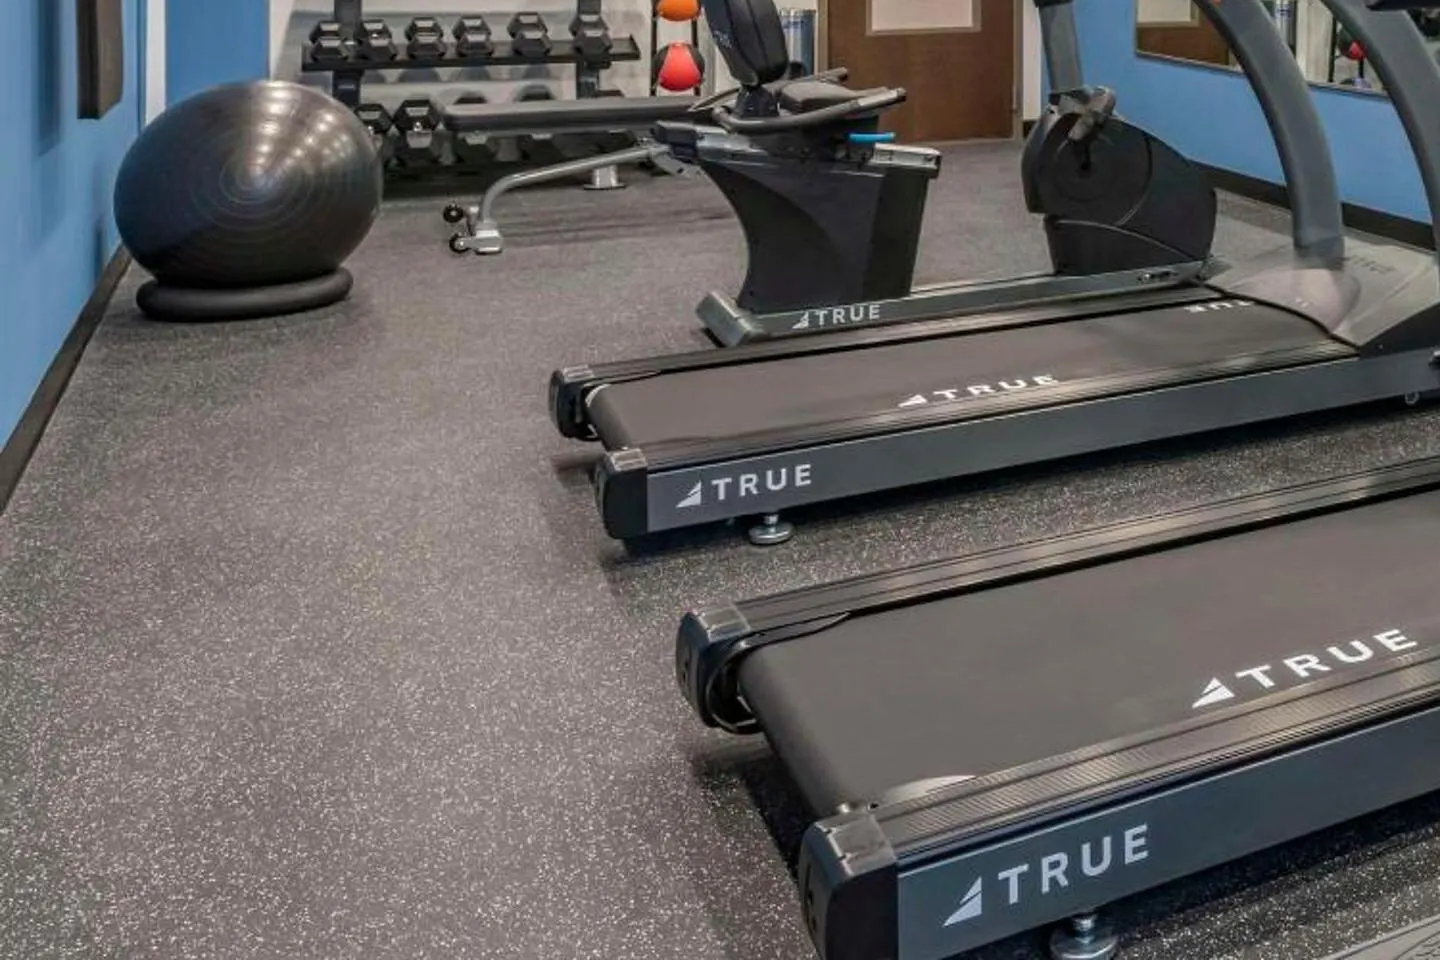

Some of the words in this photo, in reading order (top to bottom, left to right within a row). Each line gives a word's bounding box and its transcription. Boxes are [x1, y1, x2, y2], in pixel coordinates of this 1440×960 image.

[815, 304, 881, 326] TRUE
[933, 374, 1059, 399] TRUE
[711, 463, 812, 501] TRUE
[1235, 628, 1418, 689] TRUE
[999, 823, 1149, 904] TRUE
